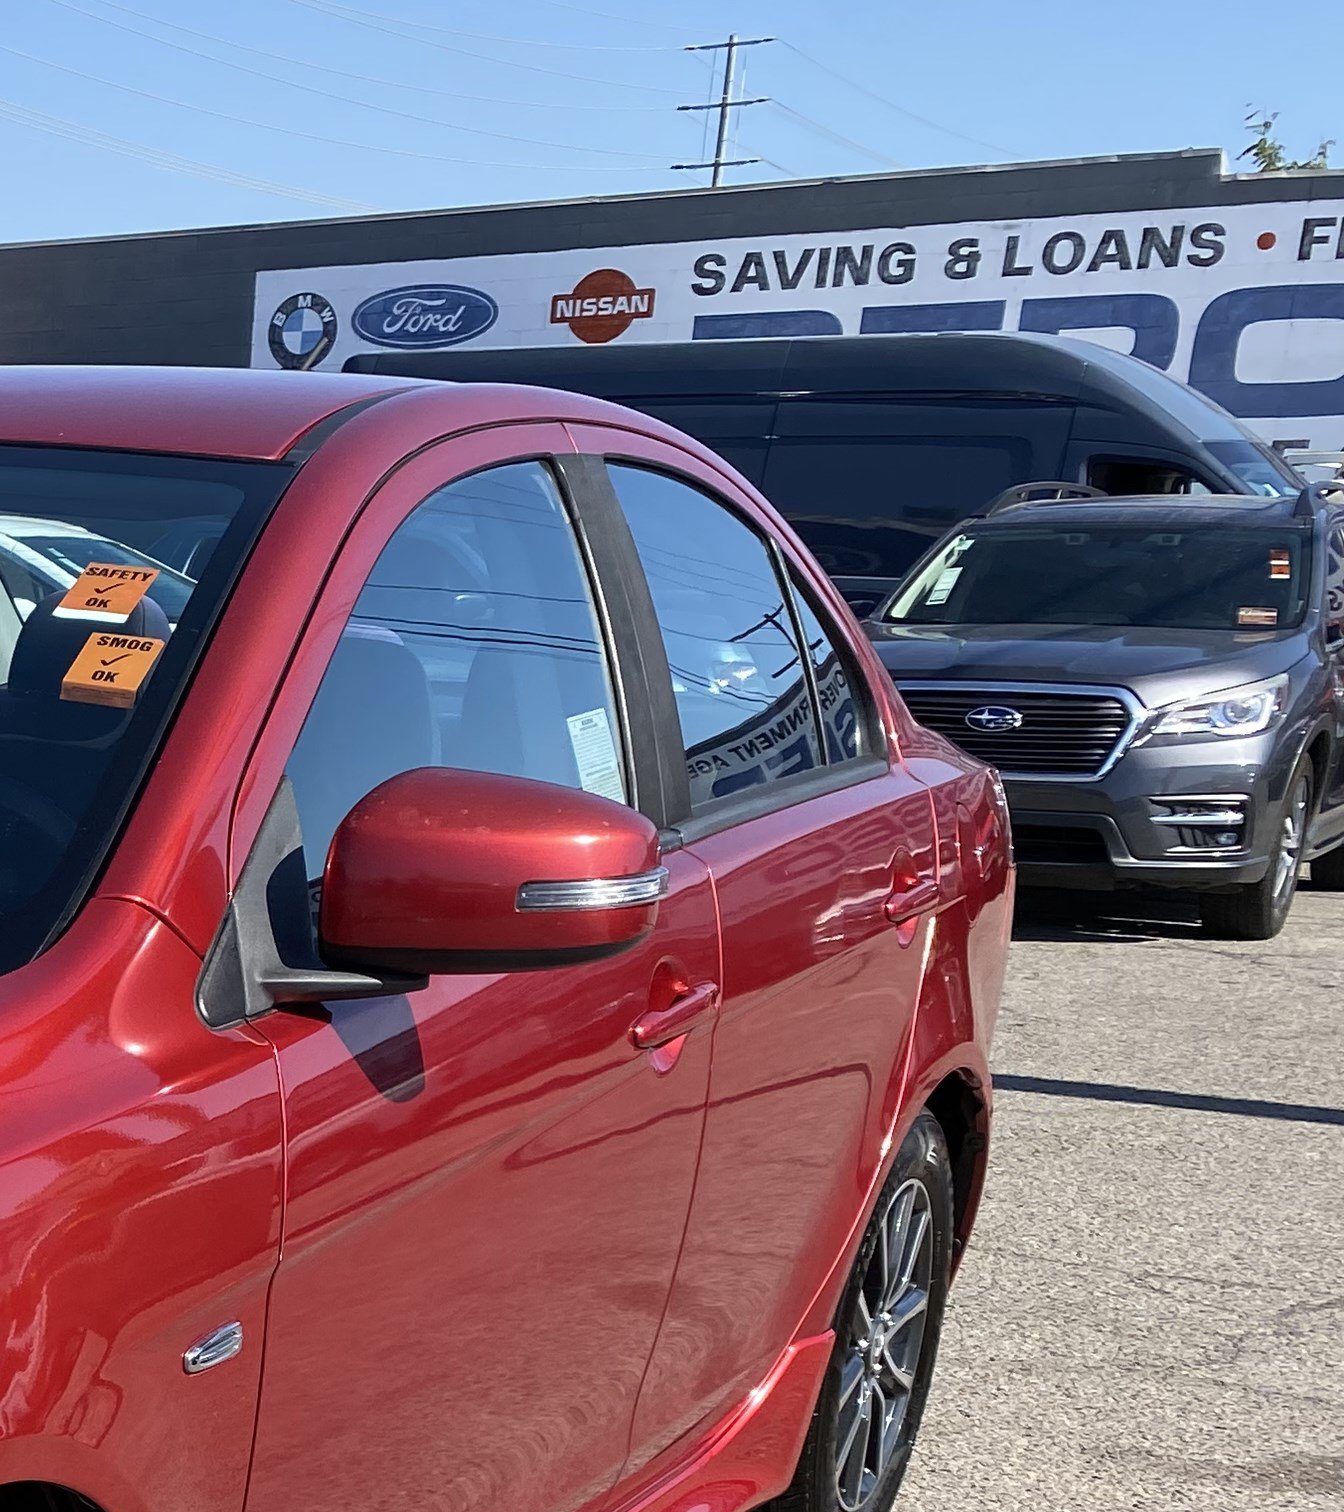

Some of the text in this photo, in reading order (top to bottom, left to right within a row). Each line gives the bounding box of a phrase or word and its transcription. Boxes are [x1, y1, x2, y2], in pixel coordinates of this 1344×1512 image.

[691, 222, 1227, 297] SAVING & LOANS
[271, 294, 335, 327] BMW
[382, 298, 463, 334] Ford
[555, 294, 649, 319] NISSAN
[85, 567, 154, 582] SAFETY
[85, 598, 111, 609] OK
[97, 635, 154, 652] SMOG
[91, 670, 119, 683] OK
